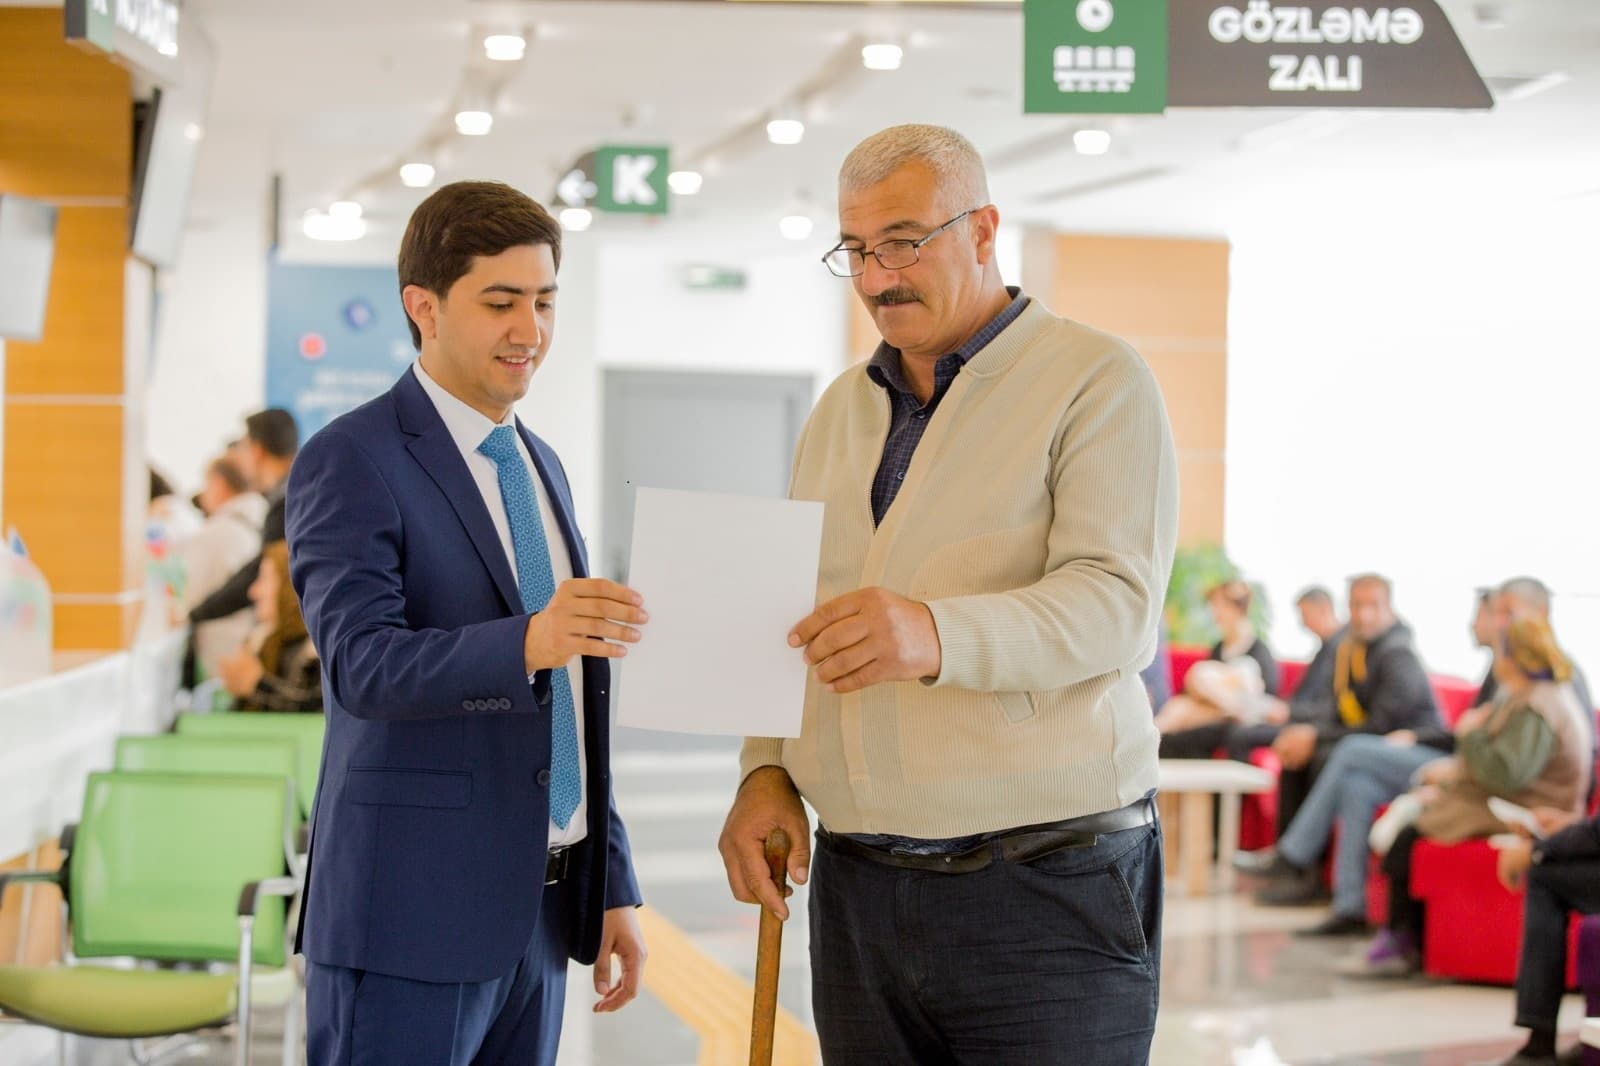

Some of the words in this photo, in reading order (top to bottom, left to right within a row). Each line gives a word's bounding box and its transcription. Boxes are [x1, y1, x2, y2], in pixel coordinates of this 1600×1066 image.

[1208, 0, 1424, 43] GÖZLƏMƏ
[1269, 55, 1362, 91] ZALI
[613, 155, 658, 205] K
